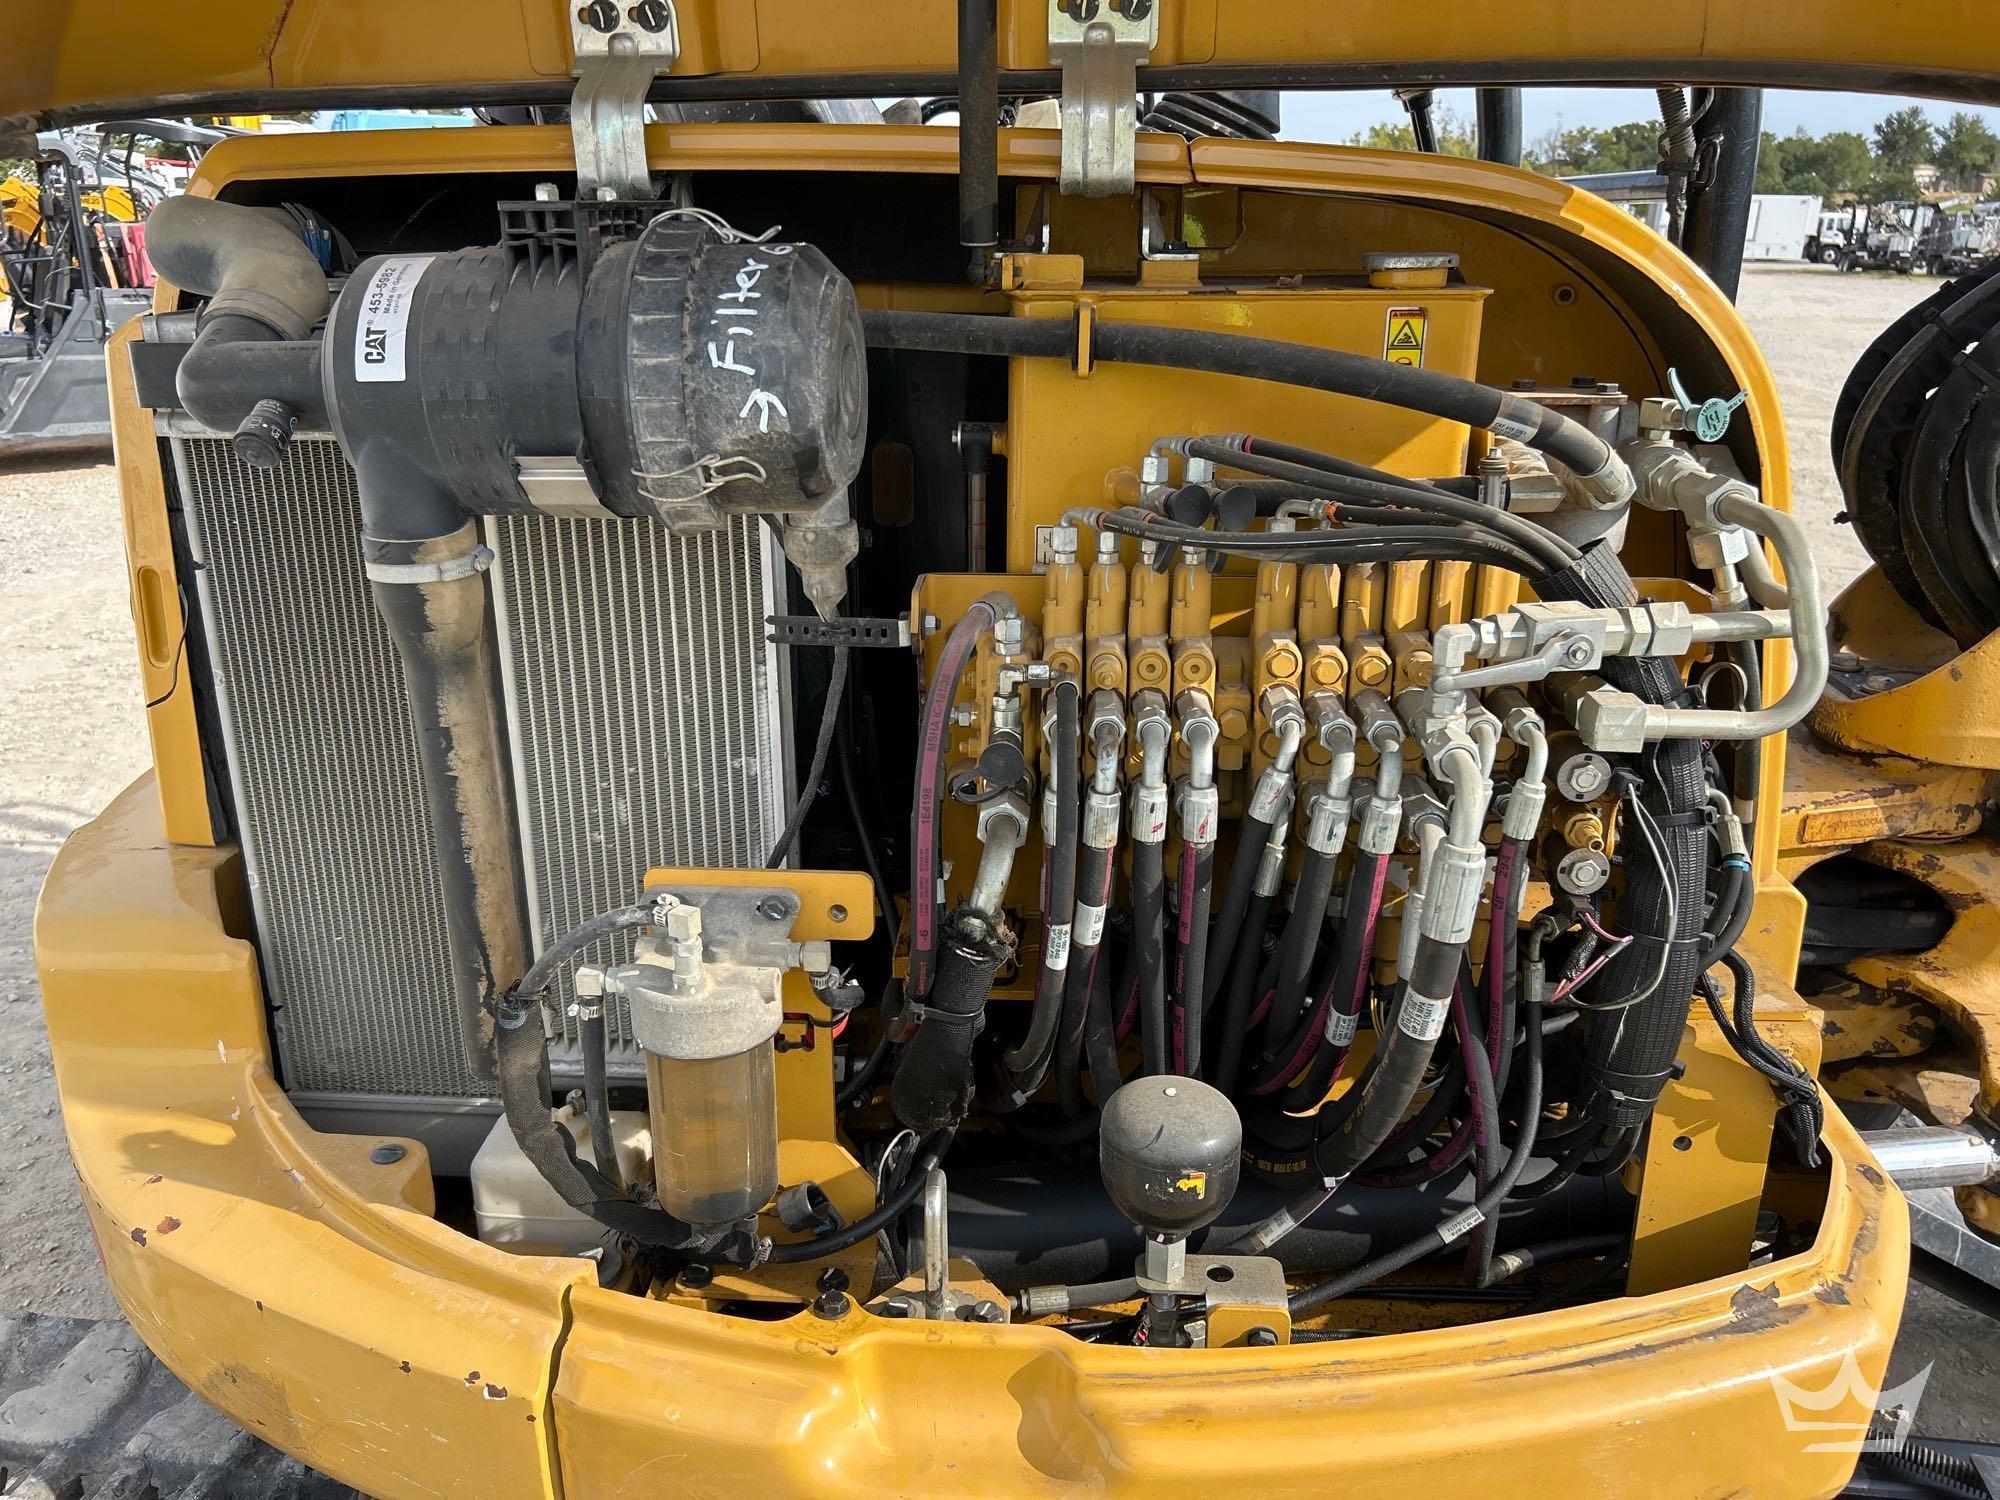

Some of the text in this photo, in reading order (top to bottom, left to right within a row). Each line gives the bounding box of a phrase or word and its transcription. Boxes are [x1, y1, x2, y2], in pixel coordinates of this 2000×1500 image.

[369, 266, 397, 314] 453-5982
[383, 294, 394, 314] Made
[393, 263, 412, 286] Germany
[708, 258, 769, 375] Filter
[921, 788, 933, 824] 1E4198
[927, 721, 940, 752] MSHA
[1498, 853, 1510, 878] 294
[917, 930, 928, 996] Compact -6
[1175, 922, 1188, 994] Compact -8
[1472, 1112, 1483, 1135] 294
